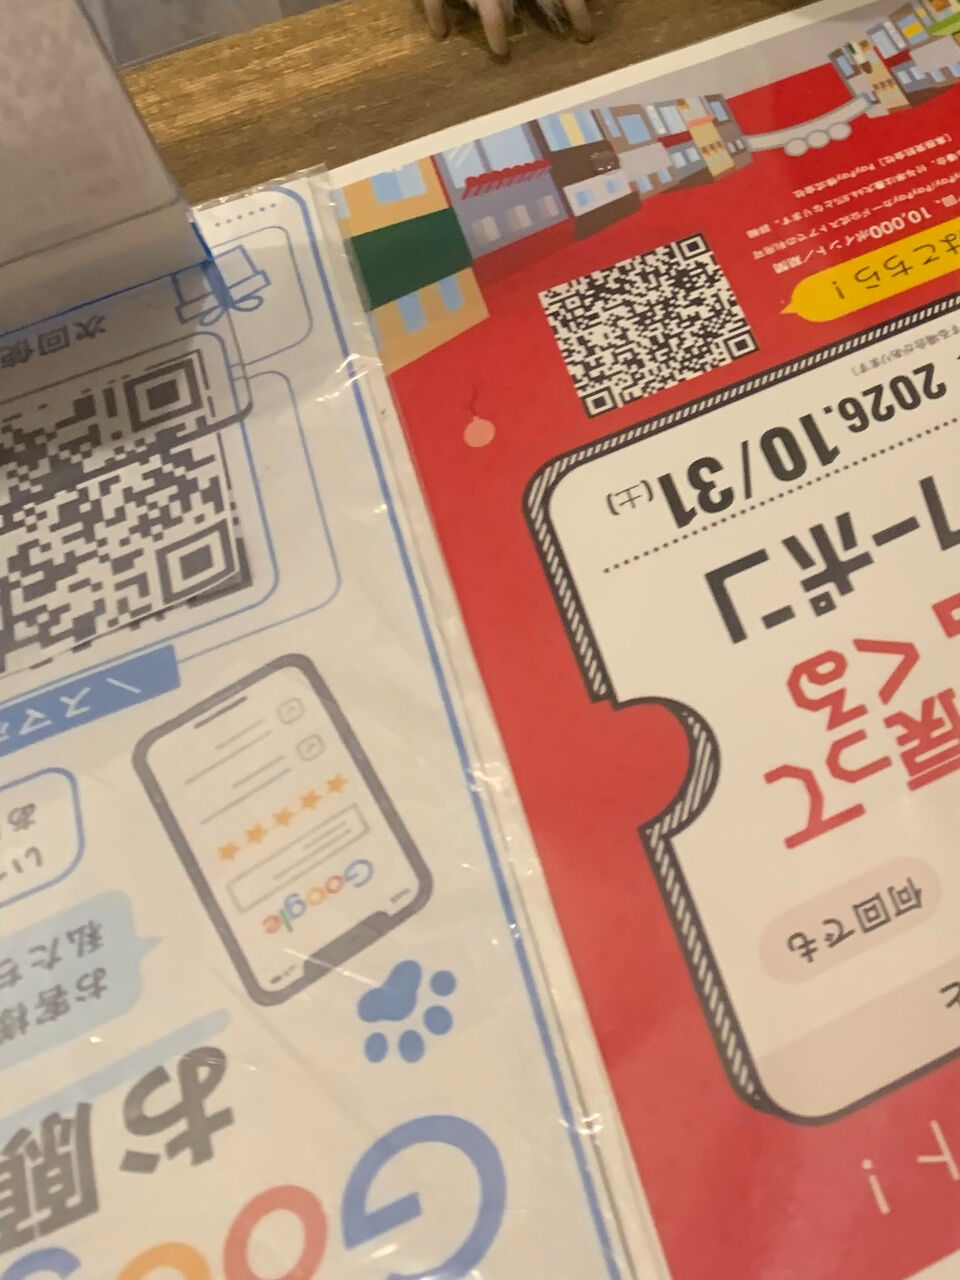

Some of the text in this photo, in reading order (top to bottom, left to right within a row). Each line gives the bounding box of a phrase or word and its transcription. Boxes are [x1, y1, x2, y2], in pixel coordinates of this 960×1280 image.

[0, 688, 91, 742] スマ
[261, 859, 375, 938] Google
[788, 878, 922, 963] 何回でも
